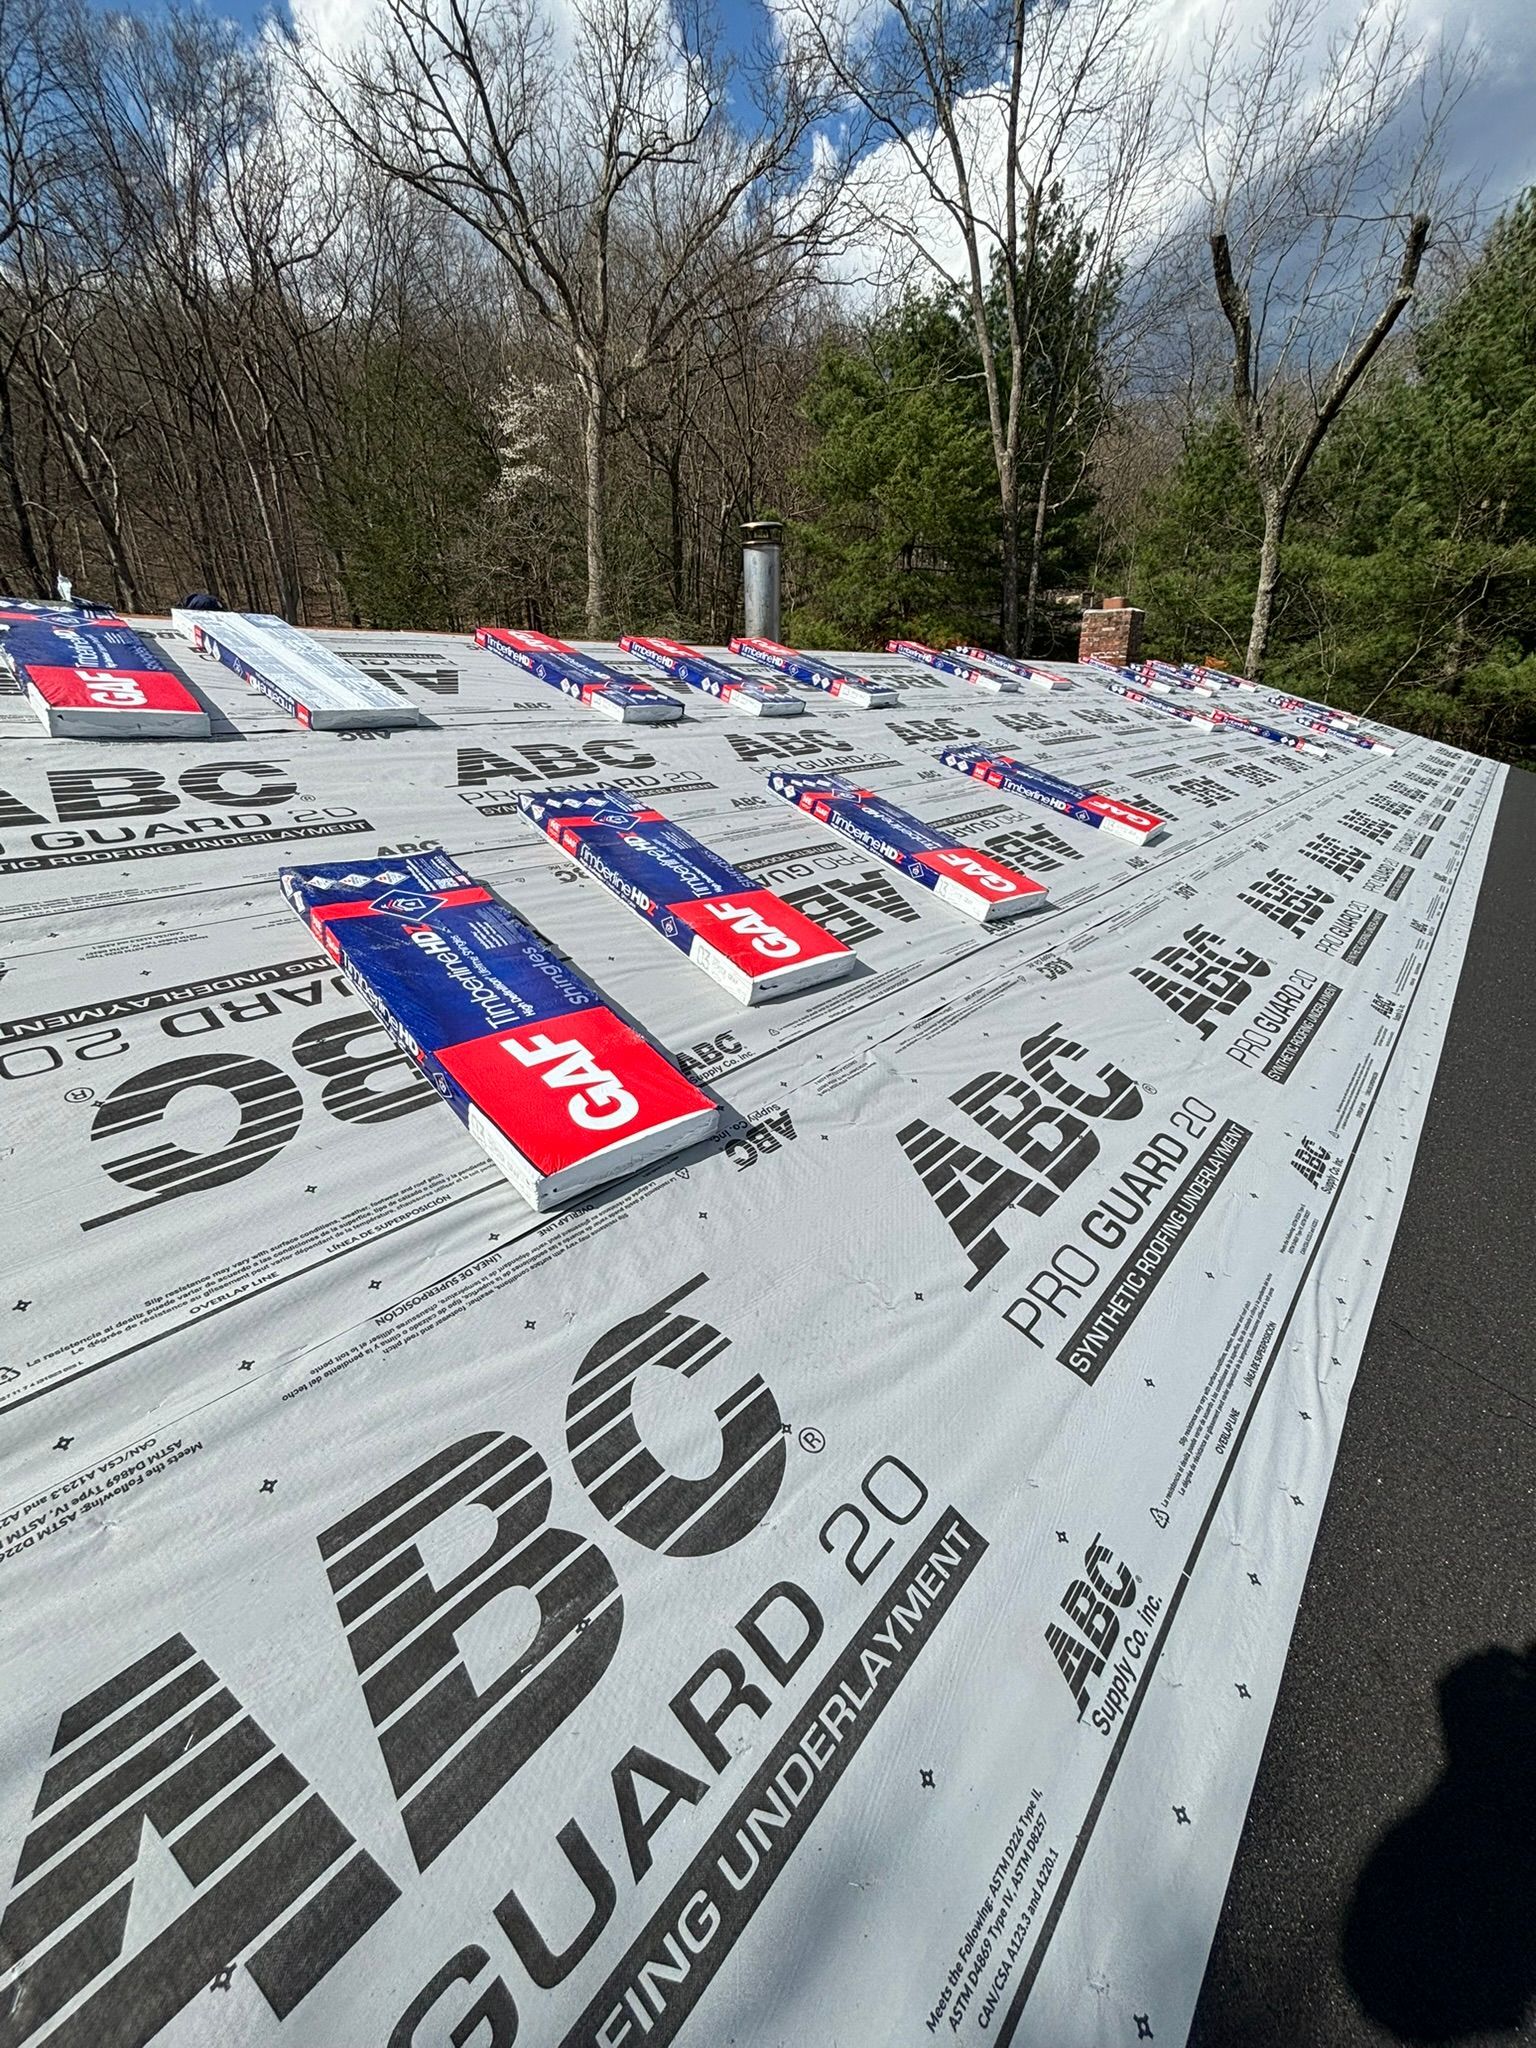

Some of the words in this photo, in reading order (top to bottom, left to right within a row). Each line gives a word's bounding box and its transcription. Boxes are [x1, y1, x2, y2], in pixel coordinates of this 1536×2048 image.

[508, 630, 560, 652] GAF
[649, 638, 694, 656] GAF
[75, 670, 147, 706] GAF
[724, 729, 854, 763] ABC
[885, 718, 981, 746] ABC
[445, 738, 656, 788] ABC
[663, 770, 703, 783] 20
[796, 755, 866, 771] GUARD
[731, 795, 767, 808] ABC
[1088, 800, 1152, 827] GAF
[31, 812, 272, 851] GUARD
[287, 806, 358, 823] 20
[50, 845, 176, 866] ROOFING
[183, 822, 367, 850] UNDERLAYMENT
[812, 851, 870, 871] PRO
[936, 853, 1017, 893] GAF
[1297, 832, 1373, 883] ABC
[779, 868, 922, 949] AB
[1236, 867, 1335, 940] ABC
[704, 902, 802, 959] GAF
[521, 944, 590, 1006] Shingles
[1035, 956, 1074, 982] ABC
[1128, 923, 1272, 1042] ABC
[1226, 1026, 1266, 1069] PRO
[1261, 986, 1307, 1034] GUARD
[1288, 967, 1319, 989] 20
[0, 1028, 131, 1081] 20
[675, 1029, 743, 1076] ABC
[499, 1032, 640, 1131] GAF
[689, 1065, 723, 1085] Supply
[747, 1103, 781, 1123] Supply
[724, 1108, 798, 1172] ABC
[896, 1021, 1144, 1292] ABC
[1290, 1135, 1331, 1190] ABC
[326, 1234, 360, 1253] LÍNEA
[358, 1227, 375, 1239] DE
[372, 1193, 452, 1232] SUPERPOSICIÓN
[538, 1220, 558, 1236] LINE
[556, 1202, 594, 1225] OVERLAP
[997, 1239, 1107, 1350] PRO
[1077, 1129, 1195, 1254] GUARD
[1167, 1091, 1219, 1144] 20
[145, 1295, 163, 1307] Slip
[164, 1273, 210, 1298] resistance
[211, 1265, 230, 1278] may
[231, 1256, 250, 1269] vary
[250, 1248, 268, 1260] with
[269, 1234, 299, 1252] surface
[298, 1218, 340, 1238] conditions,
[339, 1204, 370, 1221] weather,
[369, 1191, 399, 1207] footwear
[400, 1185, 412, 1193] and
[412, 1179, 426, 1188] roof
[427, 1172, 443, 1182] pitch
[1066, 1269, 1148, 1376] SYNTHETIC
[1133, 1207, 1189, 1276] ROOFING
[1175, 1122, 1246, 1215] UNDERLAYMENT
[457, 1266, 473, 1282] DE
[471, 1251, 501, 1274] LÍNEA
[189, 1283, 250, 1314] OVERLAP
[251, 1270, 279, 1287] LINE
[374, 1274, 460, 1328] SUPERPOSICIÓN
[96, 1437, 157, 1474] CAN/CSA
[144, 1461, 166, 1479] the
[147, 1439, 182, 1464] ASTM
[165, 1440, 203, 1467] Meets
[49, 1469, 97, 1500] A123.3
[70, 1481, 103, 1508] Type
[77, 1472, 145, 1517] Following:
[104, 1459, 146, 1488] D4869
[22, 1495, 48, 1514] and
[35, 1510, 79, 1541] ASTM
[5, 1513, 47, 1544] ASTM
[1043, 1531, 1137, 1723] ABC
[0, 1272, 788, 2048] ABC
[1092, 1655, 1137, 1737] Supply
[1123, 1628, 1149, 1660] Co.
[715, 1518, 974, 1892] UNDERLAYMENT
[387, 1579, 825, 2048] GUARD
[819, 1454, 930, 1567] 20
[1024, 1812, 1048, 1853] D8257
[1008, 1849, 1032, 1890] ASTM
[923, 1983, 954, 2032] Meets
[944, 1959, 964, 1986] the
[955, 1892, 996, 1963] Following:
[985, 1855, 1011, 1897] ASTM
[1003, 1824, 1025, 1860] D226
[1017, 1796, 1038, 1829] Type
[1030, 1785, 1044, 1803] II,
[1001, 1887, 1018, 1909] IV,
[975, 1959, 1012, 2029] CAN/CSA
[1003, 1911, 1032, 1962] A123.3
[1023, 1887, 1043, 1915] and
[1033, 1846, 1059, 1892] A220.1
[986, 1904, 1010, 1942] Type
[966, 1936, 994, 1987] D4869
[945, 1982, 974, 2032] ASTM
